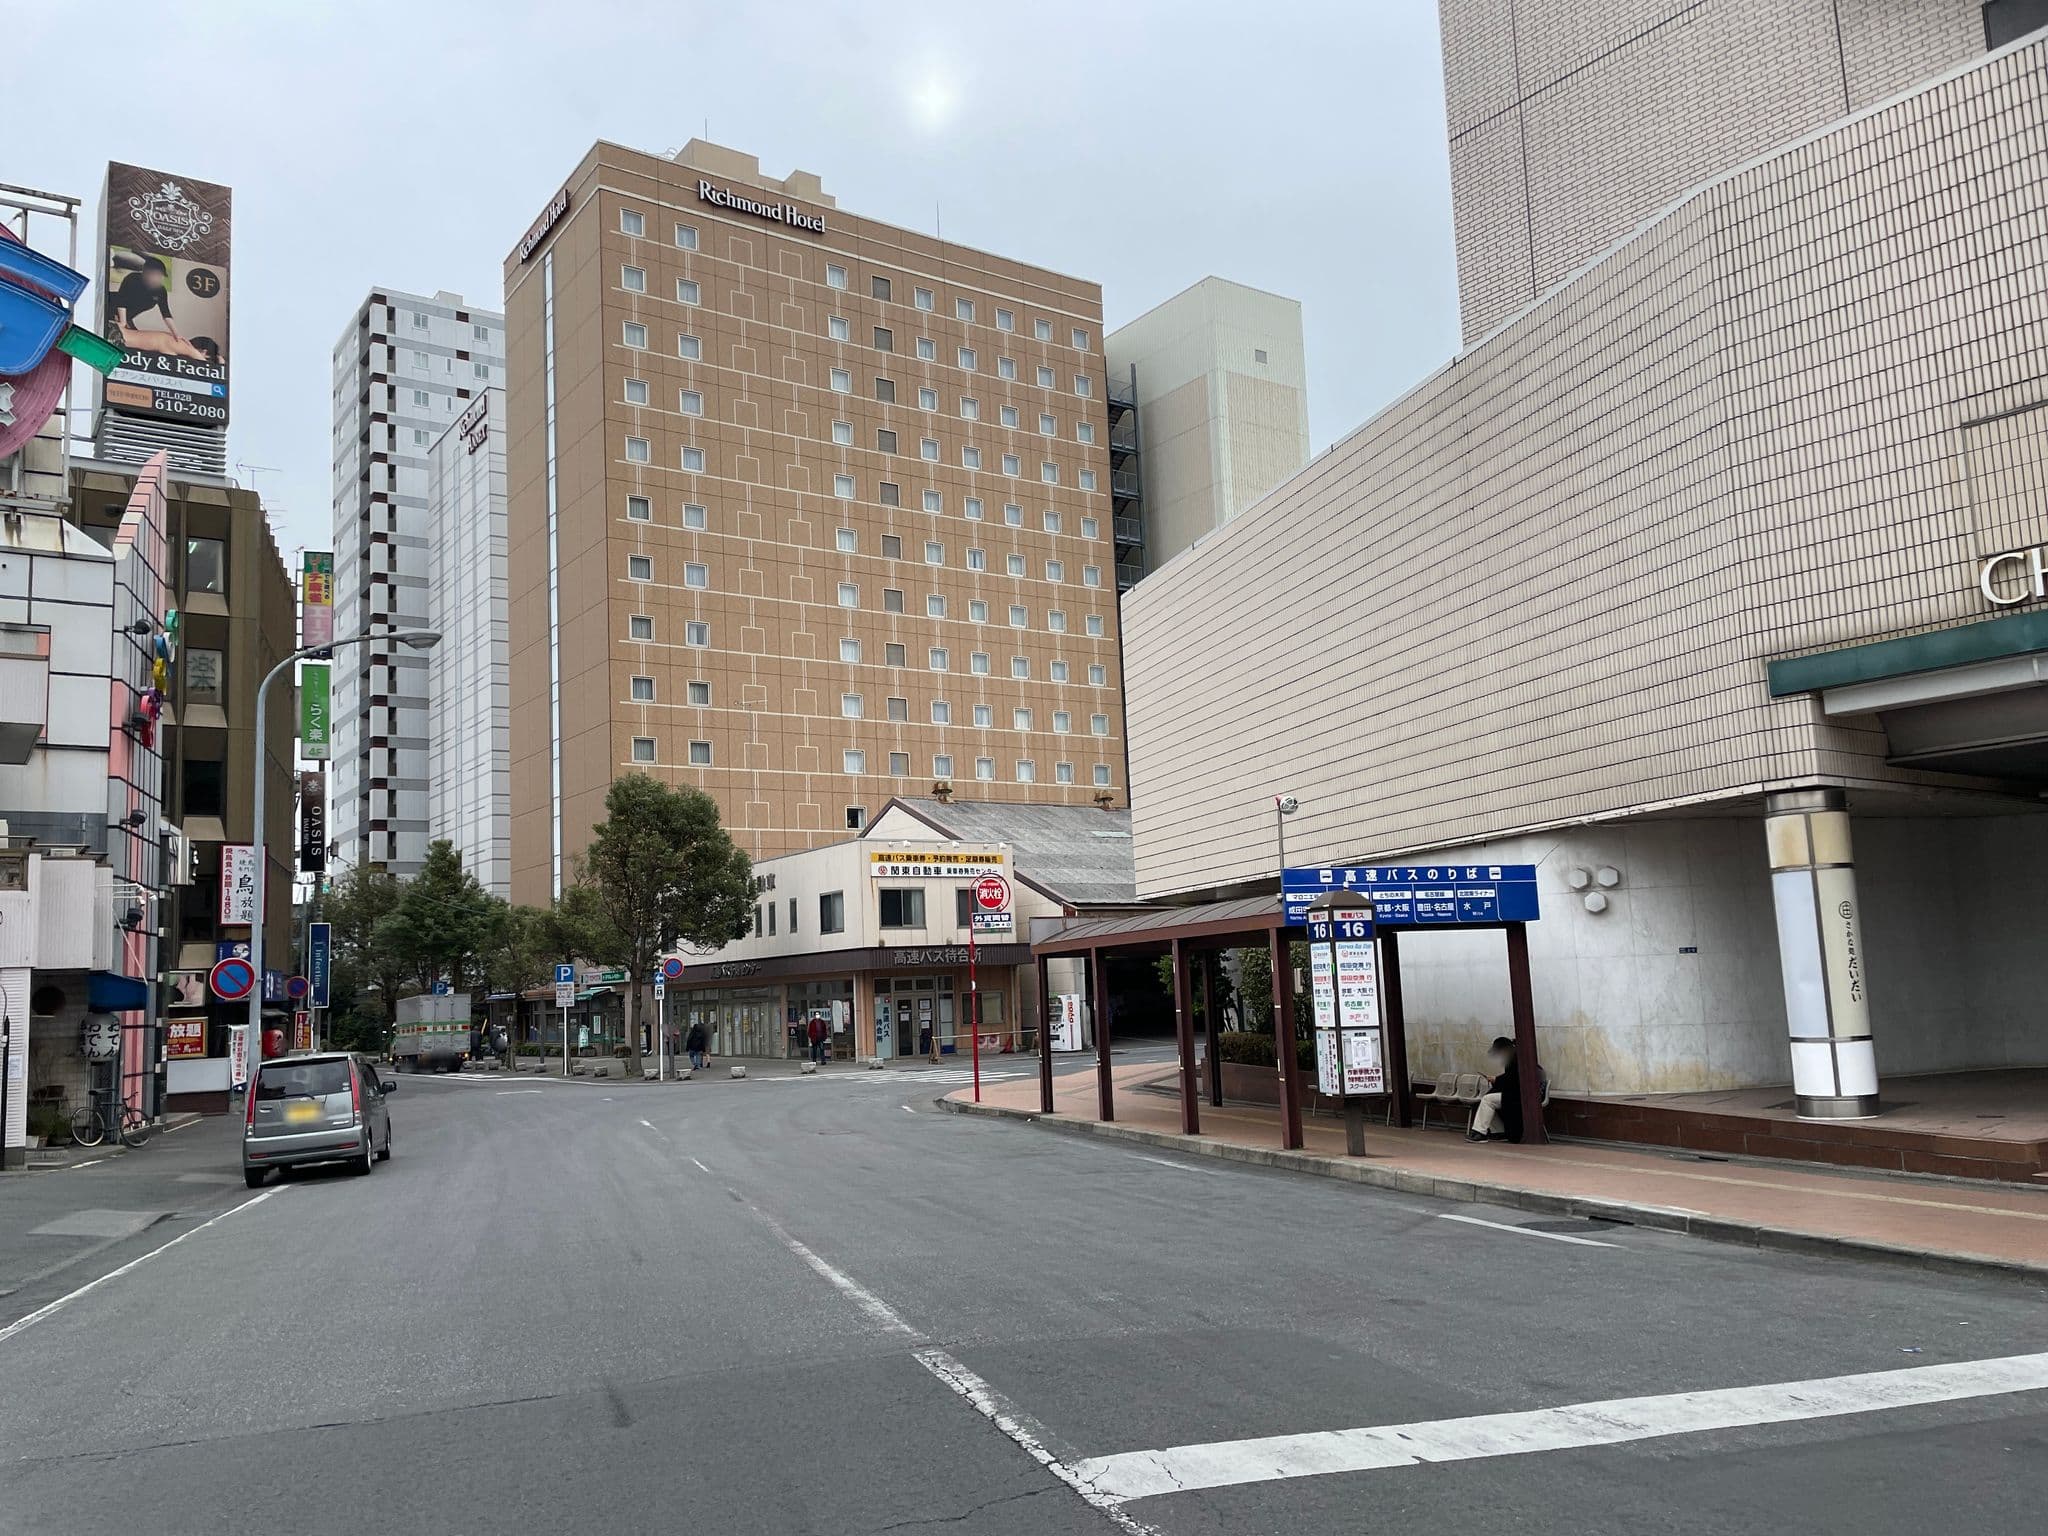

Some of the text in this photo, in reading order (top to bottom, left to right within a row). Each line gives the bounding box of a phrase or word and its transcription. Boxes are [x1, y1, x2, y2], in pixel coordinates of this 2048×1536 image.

[697, 179, 826, 233] Richmond Hotel
[153, 211, 189, 226] OASIS
[192, 275, 217, 292] 3F
[120, 351, 226, 380] ody & Facial
[155, 398, 226, 420] 610-2080
[308, 746, 323, 757] 4F
[311, 806, 322, 856] OASIS
[890, 865, 942, 876] 関東自動車
[1344, 868, 1478, 883] 高速バスのりば
[979, 888, 1003, 900] 消火栓
[1375, 904, 1410, 912] 京都・大阪
[1416, 902, 1454, 911] 豊田・名古屋
[1313, 923, 1326, 938] 16
[1342, 922, 1365, 937] 16
[894, 949, 983, 965] 高速バス待合所
[560, 966, 572, 981] P
[435, 982, 446, 994] P
[882, 1006, 890, 1038] 高速バス
